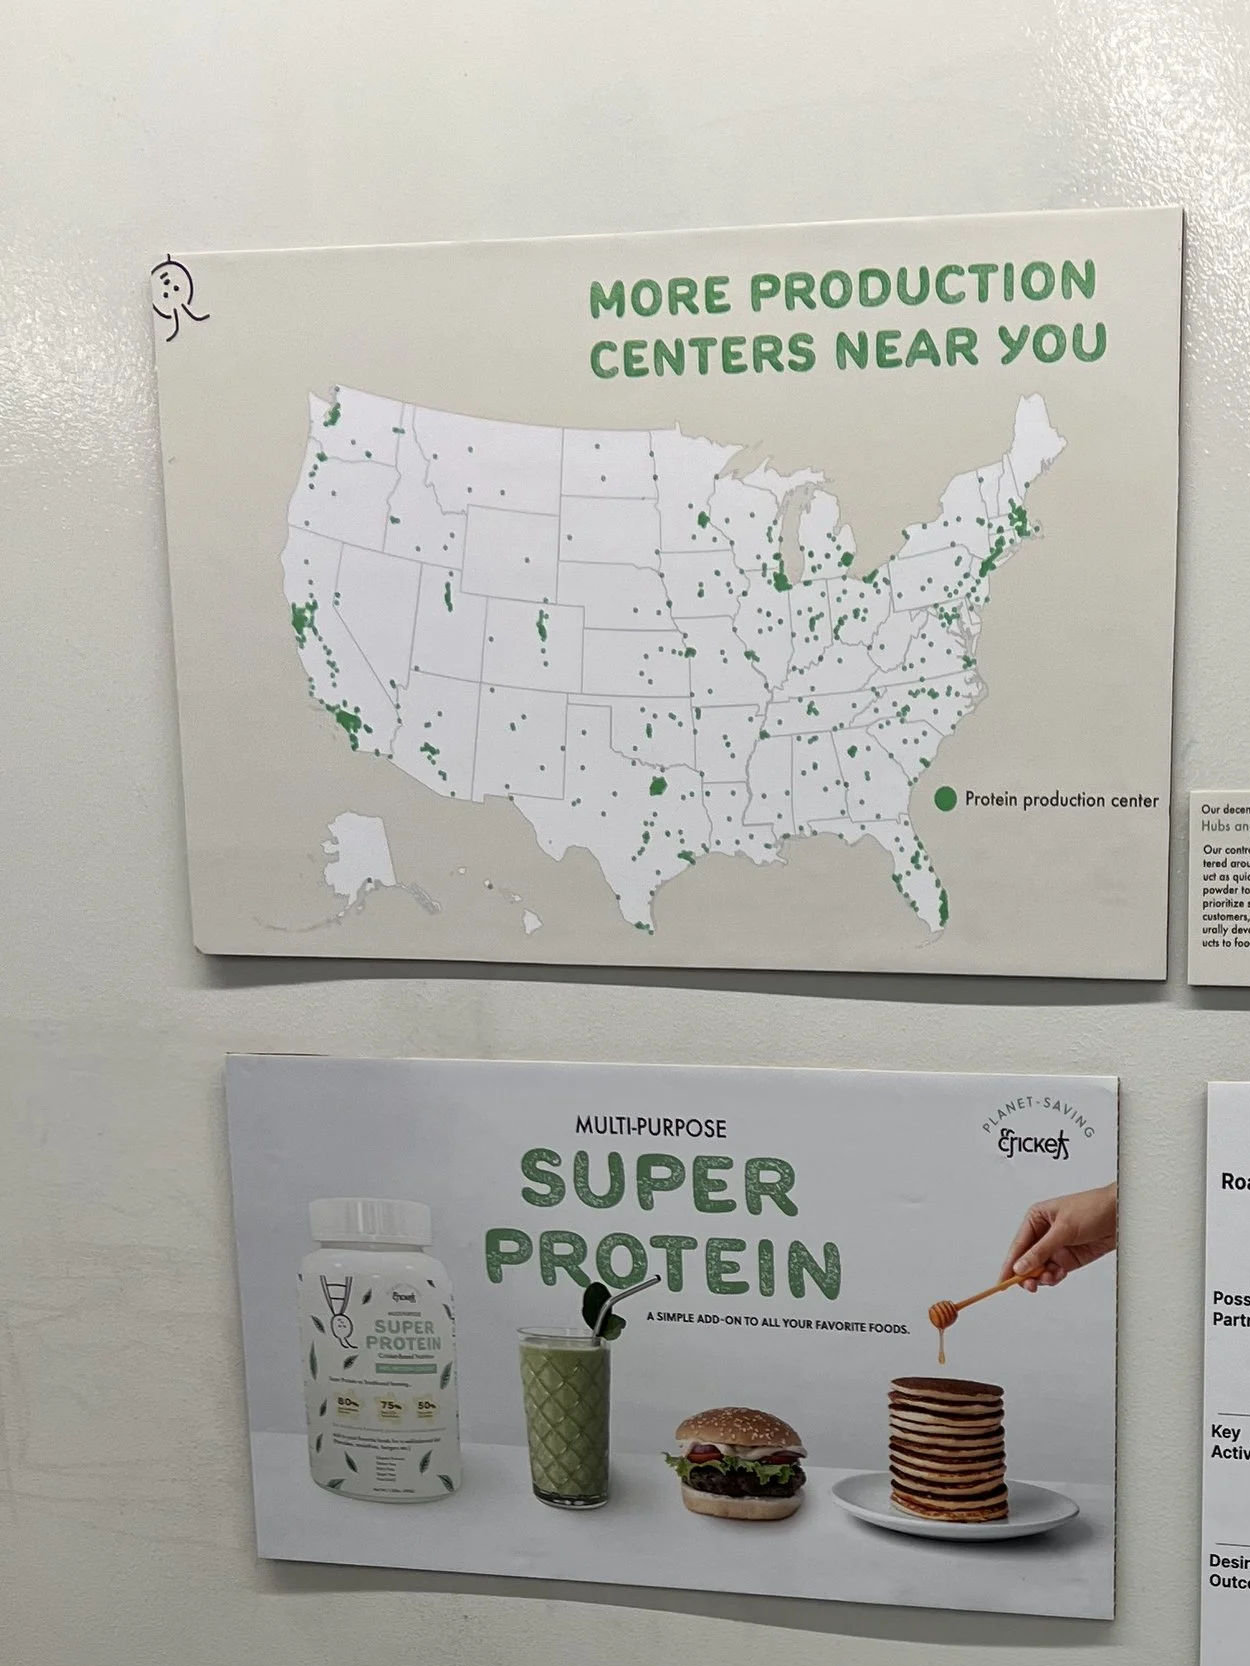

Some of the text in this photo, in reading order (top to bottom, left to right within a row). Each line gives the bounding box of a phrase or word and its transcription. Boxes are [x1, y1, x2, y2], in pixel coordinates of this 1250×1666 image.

[590, 259, 1095, 319] MORE PRODUCTION
[590, 323, 1106, 379] CENTERS NEAR YOU
[966, 790, 1159, 811] Protein production center
[1202, 804, 1220, 814] Our
[1202, 818, 1230, 831] Hubs
[1202, 939, 1219, 947] ucts
[1223, 939, 1231, 947] to
[576, 1115, 726, 1138] MULTI-PURPOSE
[982, 1096, 1095, 1139] PLANET-SAVING
[521, 1148, 798, 1217] SUPER
[485, 1228, 841, 1300] PROTEIN
[375, 1320, 434, 1335] SUPER
[647, 1312, 910, 1334] A SIMPLE ADD-ON TO ALL YOUR FAVORITE FOODS.
[366, 1335, 441, 1351] PROTEIN
[1212, 1424, 1241, 1442] Key
